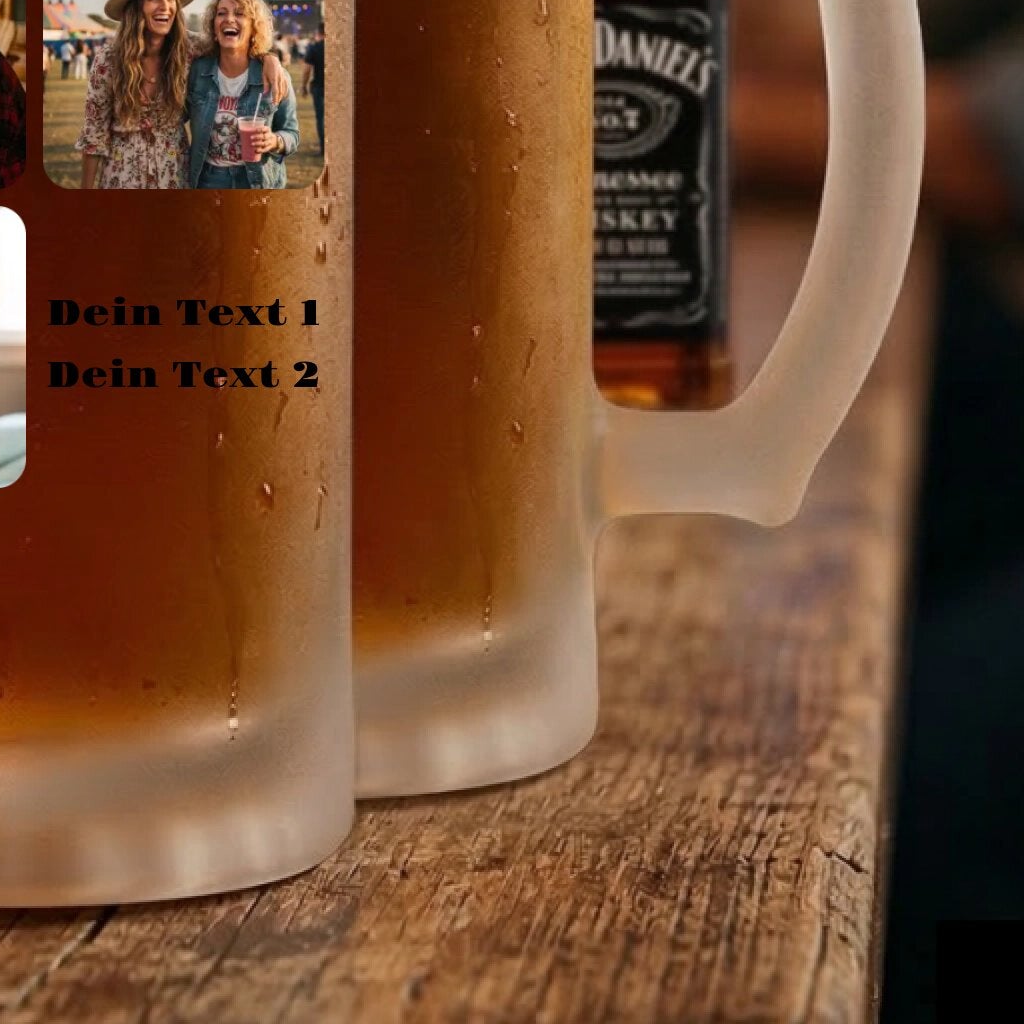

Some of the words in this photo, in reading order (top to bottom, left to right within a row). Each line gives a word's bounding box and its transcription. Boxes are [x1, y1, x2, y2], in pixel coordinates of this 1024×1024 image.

[592, 209, 680, 232] ISKEY
[47, 296, 163, 326] Dein
[176, 298, 287, 326] Text
[301, 299, 320, 326] 1
[47, 358, 159, 388] Dein
[172, 360, 280, 388] Text
[293, 361, 319, 388] 2
